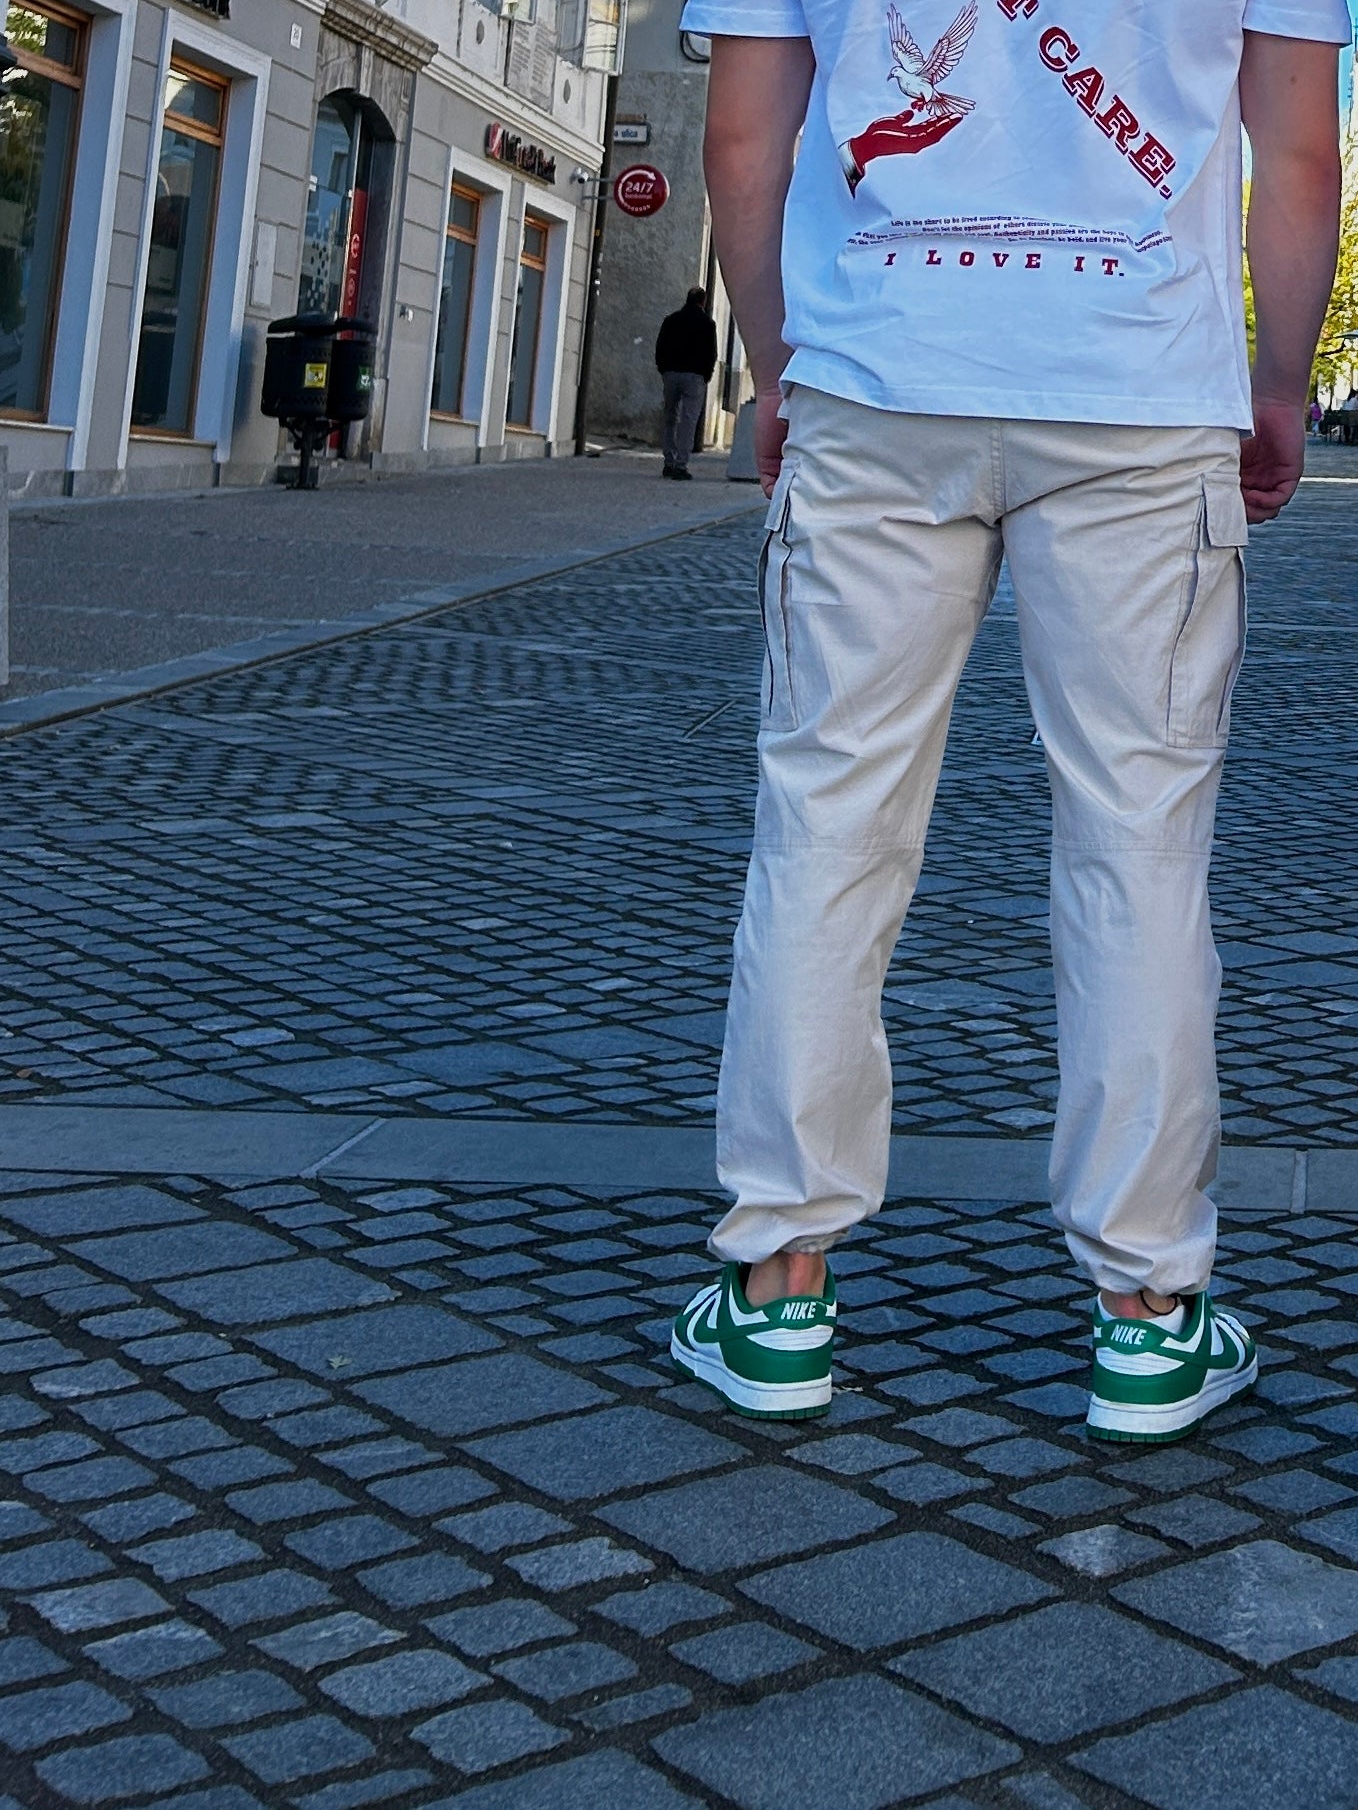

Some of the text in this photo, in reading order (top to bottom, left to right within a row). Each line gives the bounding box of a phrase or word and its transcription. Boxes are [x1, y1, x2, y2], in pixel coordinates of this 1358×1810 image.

[1039, 25, 1177, 201] CARE.
[625, 181, 655, 193] 24/7
[884, 249, 1124, 277] I LOVE IT.
[780, 1301, 817, 1320] NIKE
[1110, 1324, 1147, 1346] NIKE
